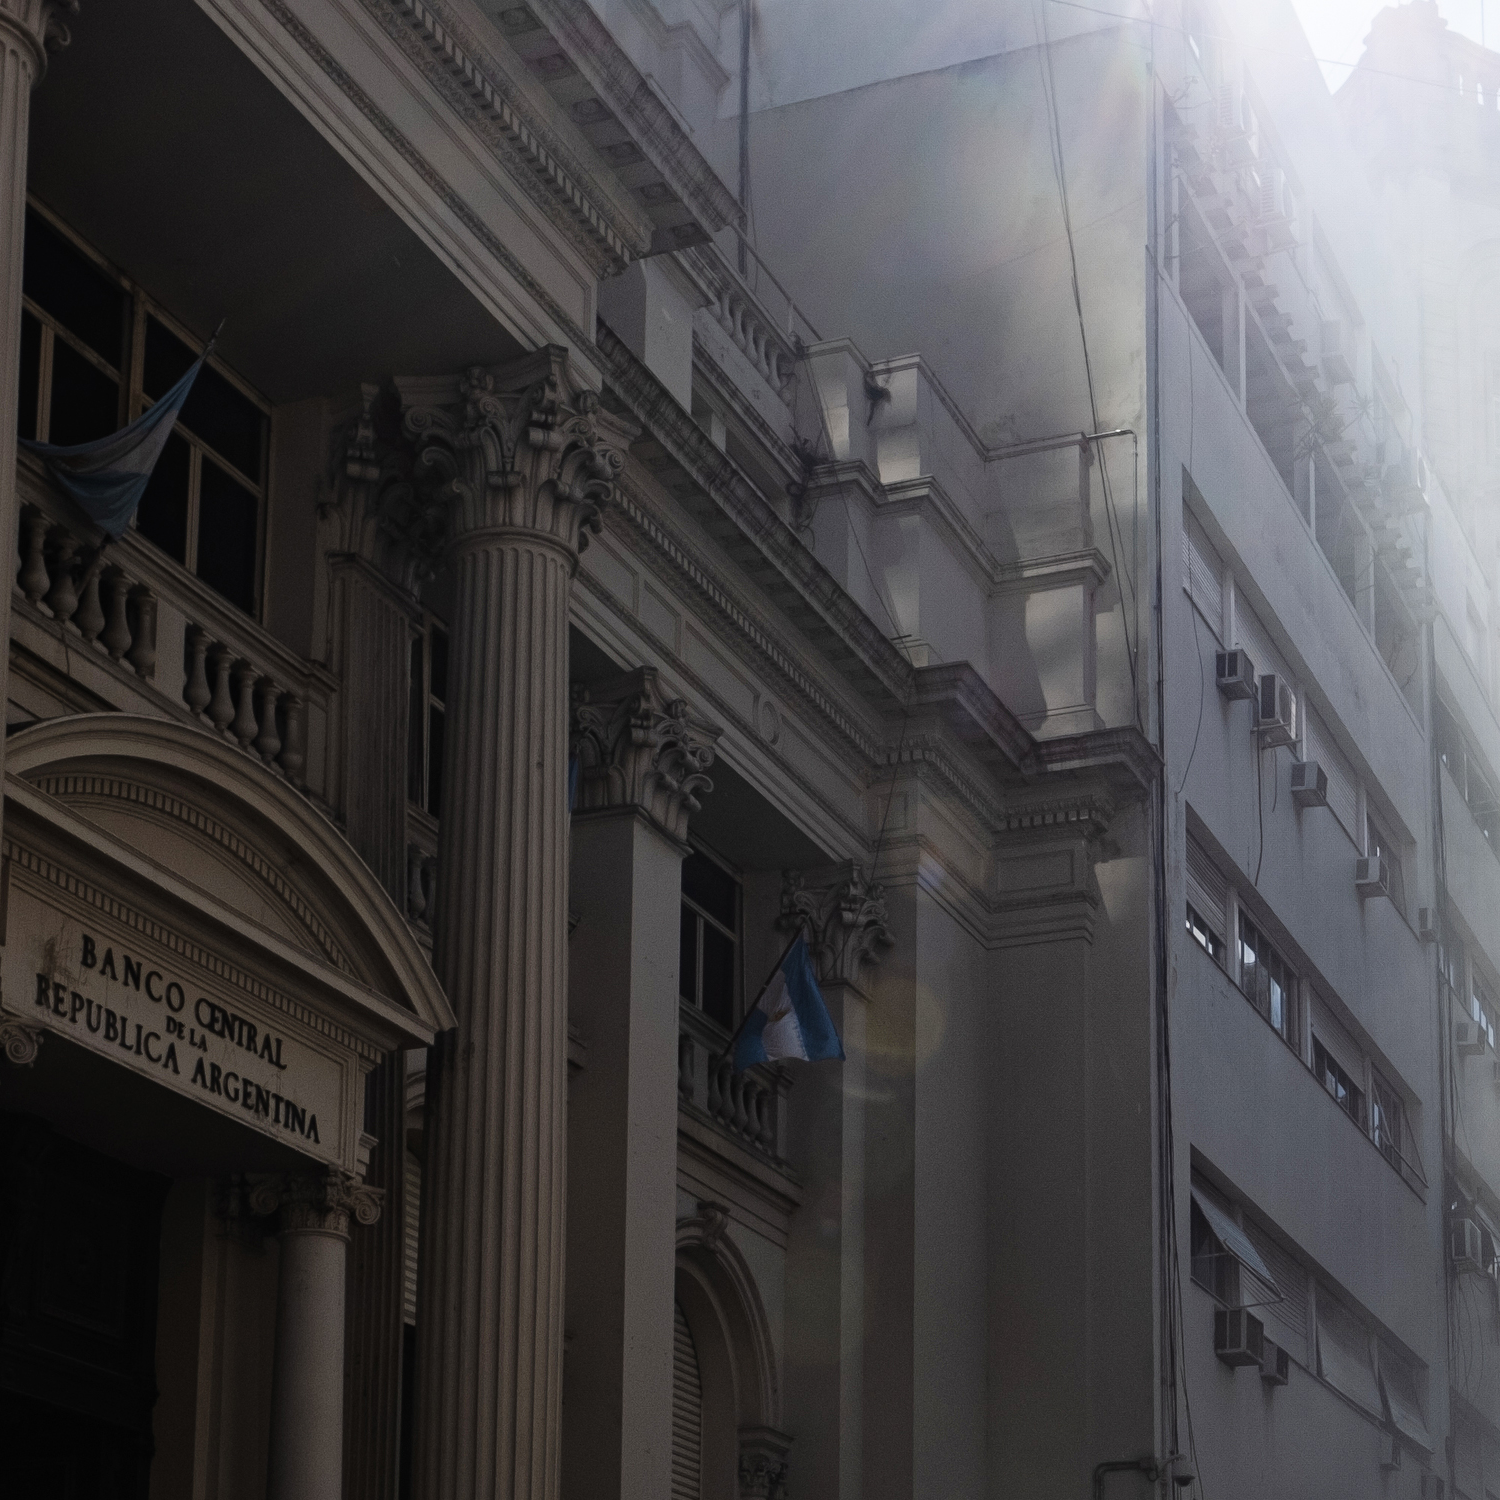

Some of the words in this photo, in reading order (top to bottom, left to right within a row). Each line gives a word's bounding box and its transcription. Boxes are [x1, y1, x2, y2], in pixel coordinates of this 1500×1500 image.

[35, 973, 181, 1075] REPUBLICA
[190, 1055, 320, 1144] ARGENTINA
[80, 933, 185, 1013] BANCO
[194, 997, 287, 1071] CENTRAL
[165, 1014, 186, 1040] DE
[189, 1023, 208, 1053] LA
